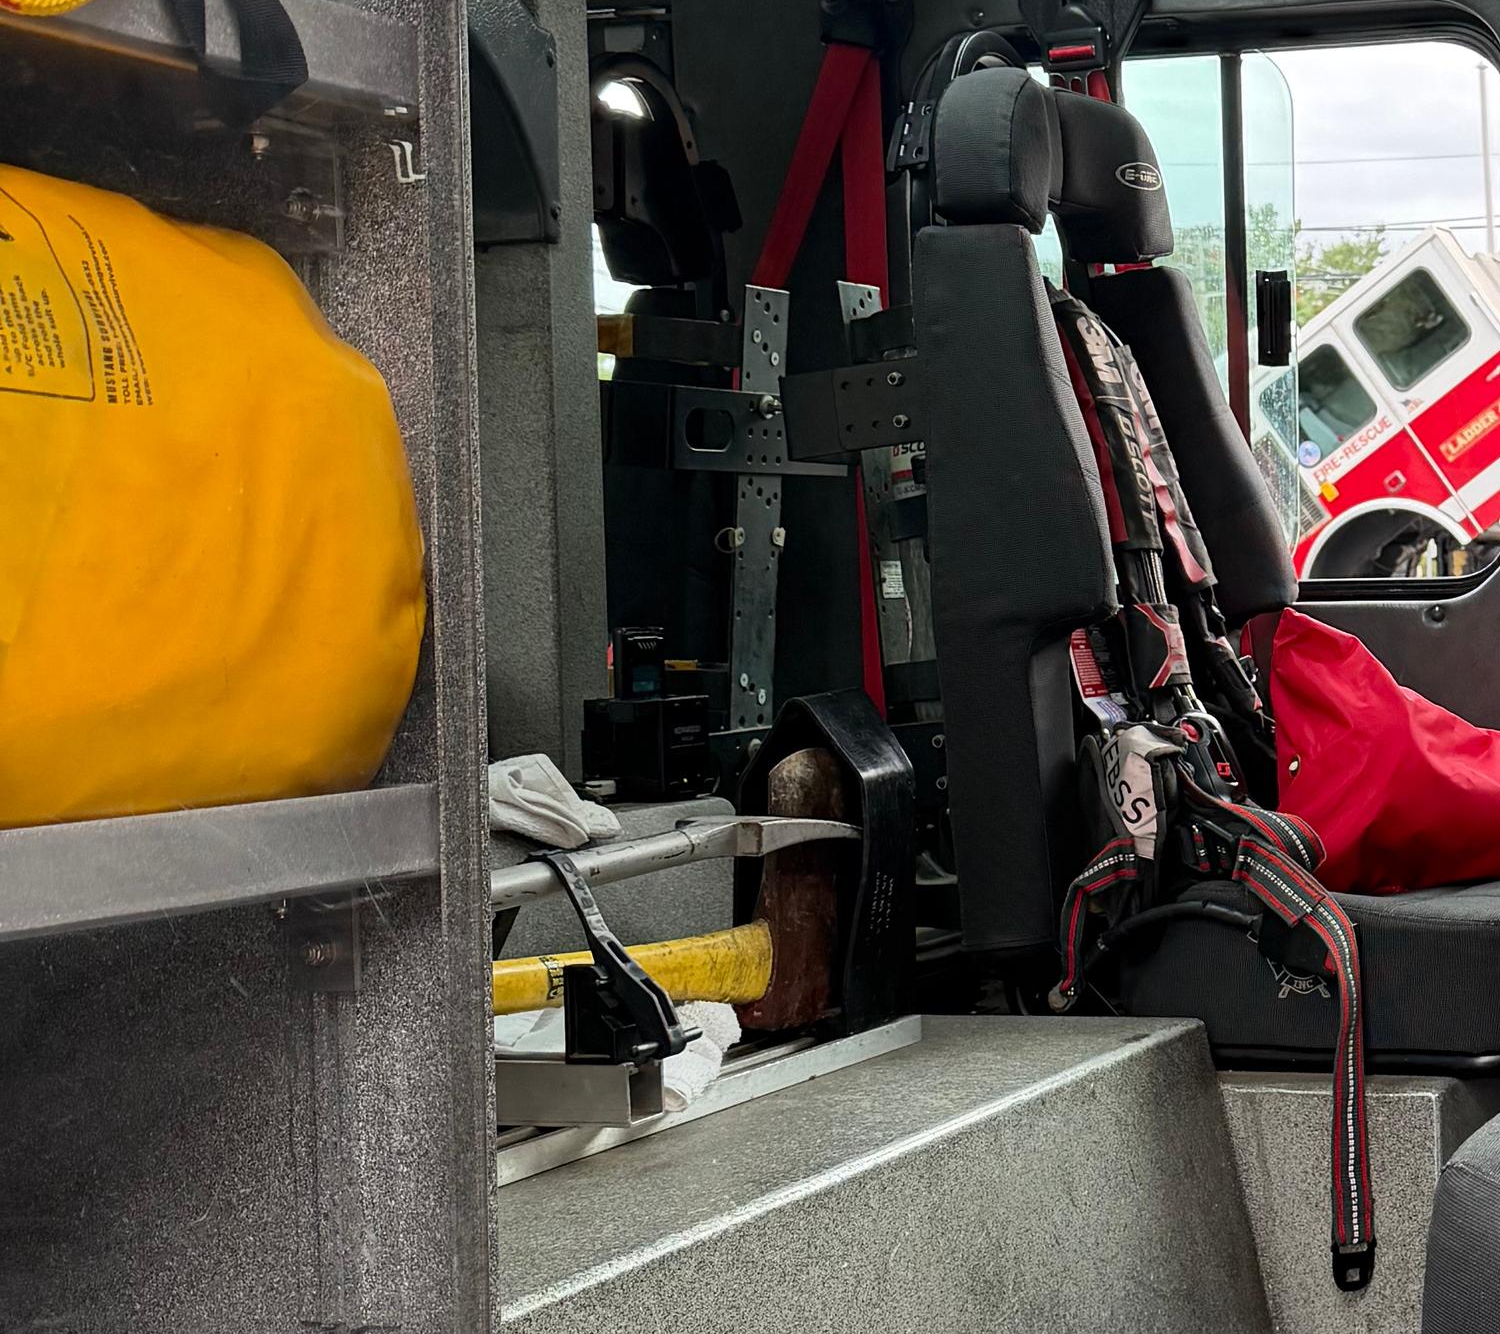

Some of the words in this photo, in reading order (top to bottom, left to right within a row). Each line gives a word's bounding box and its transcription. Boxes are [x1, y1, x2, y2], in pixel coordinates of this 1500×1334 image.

[14, 275, 27, 302] back
[23, 305, 33, 324] the
[31, 300, 42, 319] the
[46, 309, 60, 329] suit
[30, 328, 44, 367] across
[37, 322, 48, 342] roll
[1077, 315, 1122, 383] 3M
[44, 346, 56, 368] and
[53, 333, 66, 369] whole
[102, 347, 118, 404] MUSTANG
[119, 379, 132, 405] TOLL
[1312, 415, 1394, 483] FIRE-RESCUE
[1447, 409, 1499, 454] LADDER
[1126, 441, 1156, 526] SCOTT
[1104, 740, 1151, 824] EBSS
